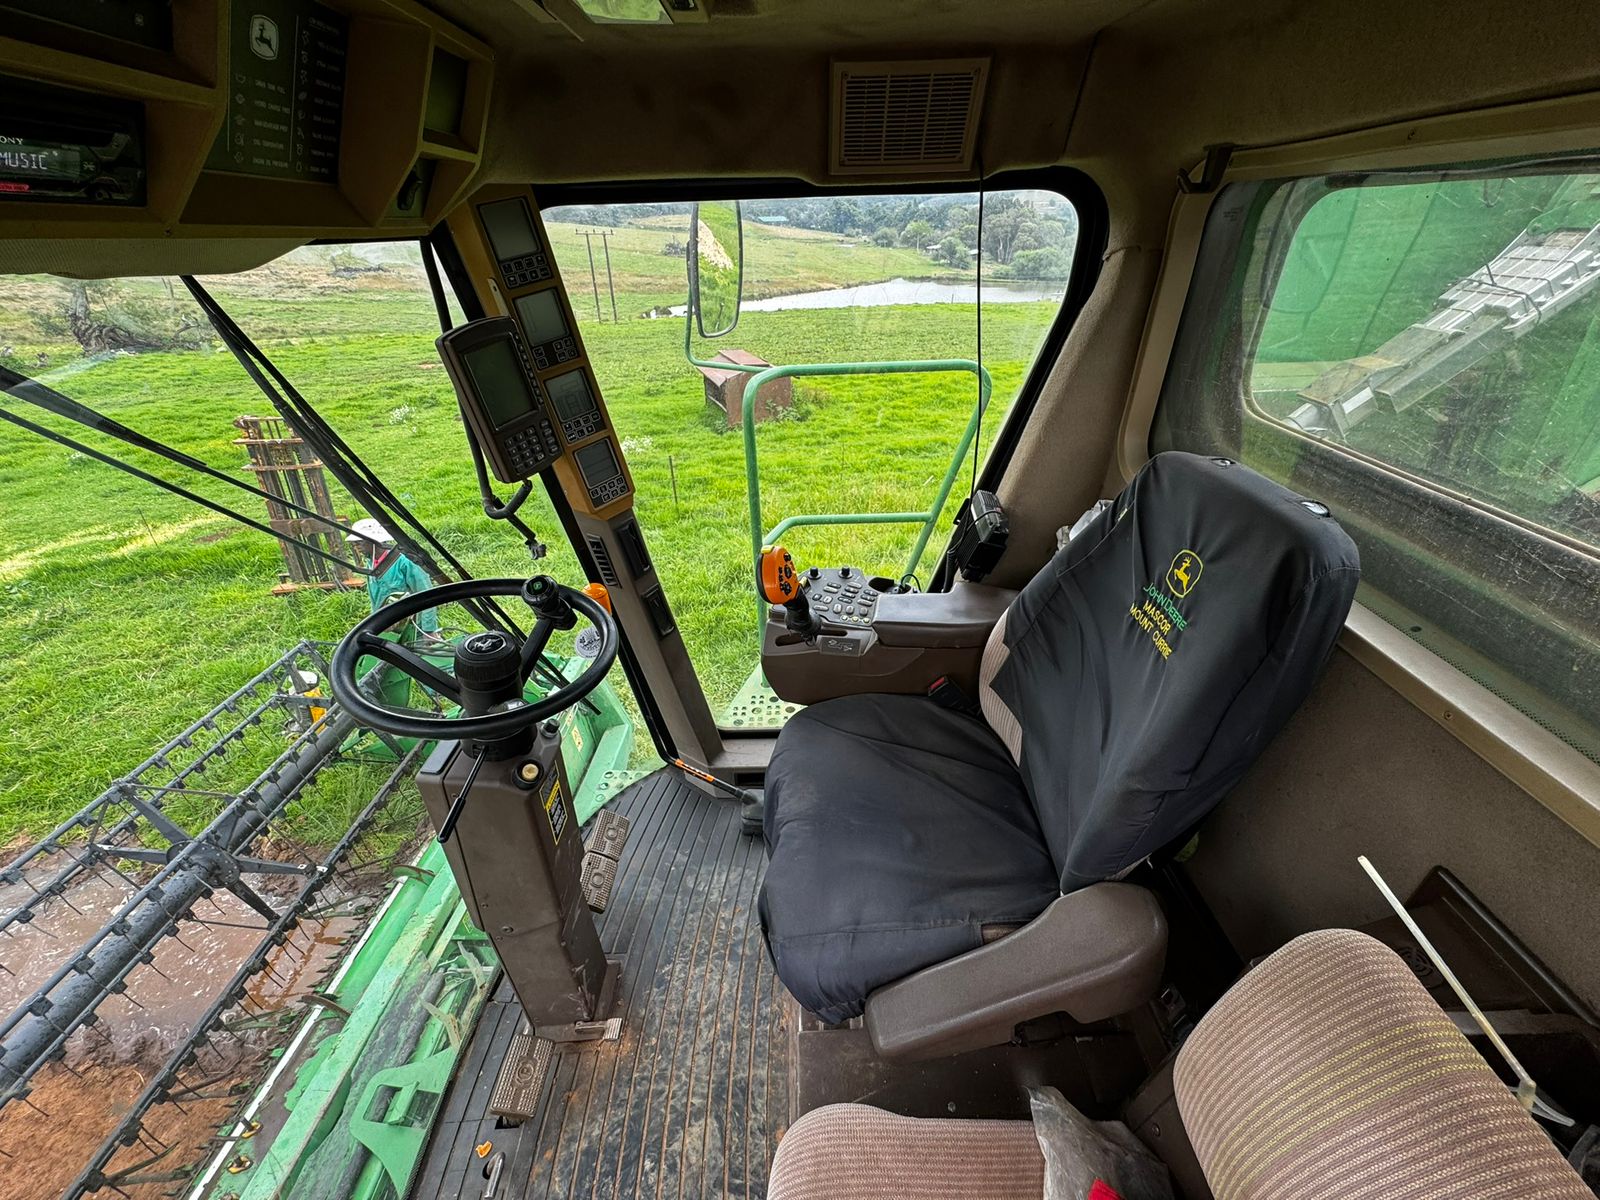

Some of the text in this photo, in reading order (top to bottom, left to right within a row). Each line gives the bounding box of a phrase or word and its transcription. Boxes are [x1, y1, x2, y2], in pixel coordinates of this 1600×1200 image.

[0, 151, 48, 170] MUSIC
[1143, 582, 1187, 631] JOHN DEERE
[1143, 600, 1171, 635] MASCOR
[1129, 602, 1172, 660] MOUNT CURRIE
